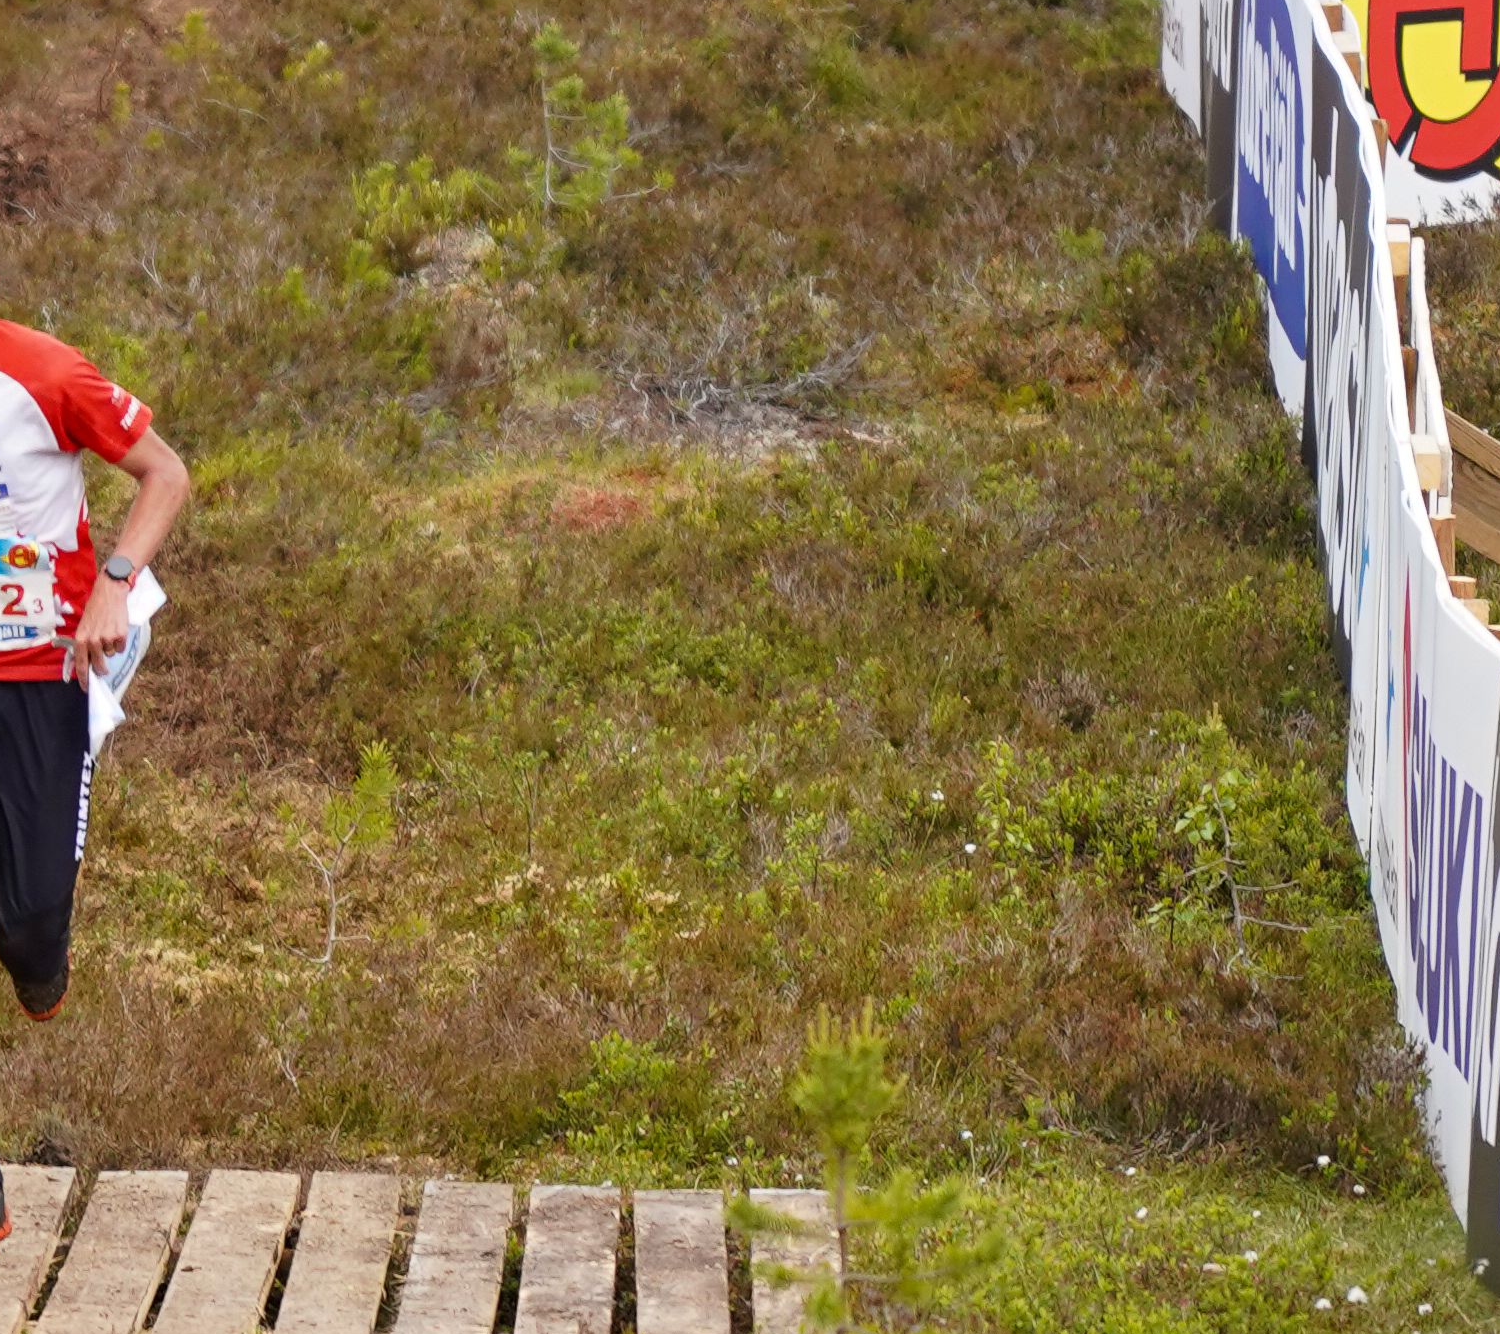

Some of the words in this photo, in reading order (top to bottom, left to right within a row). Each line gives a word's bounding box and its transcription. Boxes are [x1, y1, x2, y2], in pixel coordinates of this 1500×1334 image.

[32, 598, 44, 614] 3
[74, 750, 94, 862] TRIMTEX
[1408, 671, 1485, 1085] SUUKI
